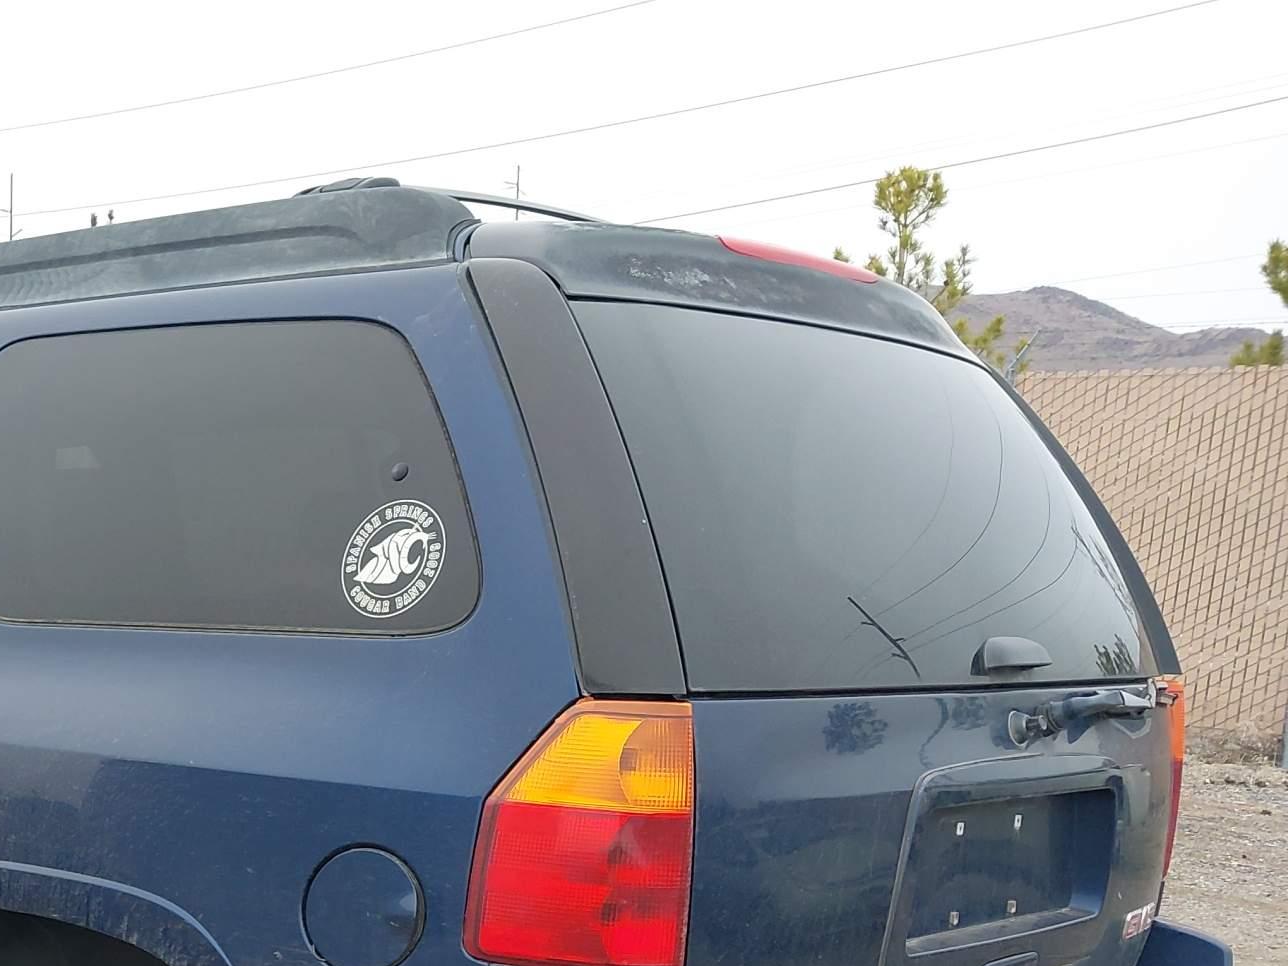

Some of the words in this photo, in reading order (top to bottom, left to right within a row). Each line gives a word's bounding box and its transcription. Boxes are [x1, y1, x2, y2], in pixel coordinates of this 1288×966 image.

[345, 514, 382, 573] SPANISH
[384, 504, 434, 529] SPRINGS
[349, 585, 390, 613] COUGAR
[395, 578, 427, 610] BAND
